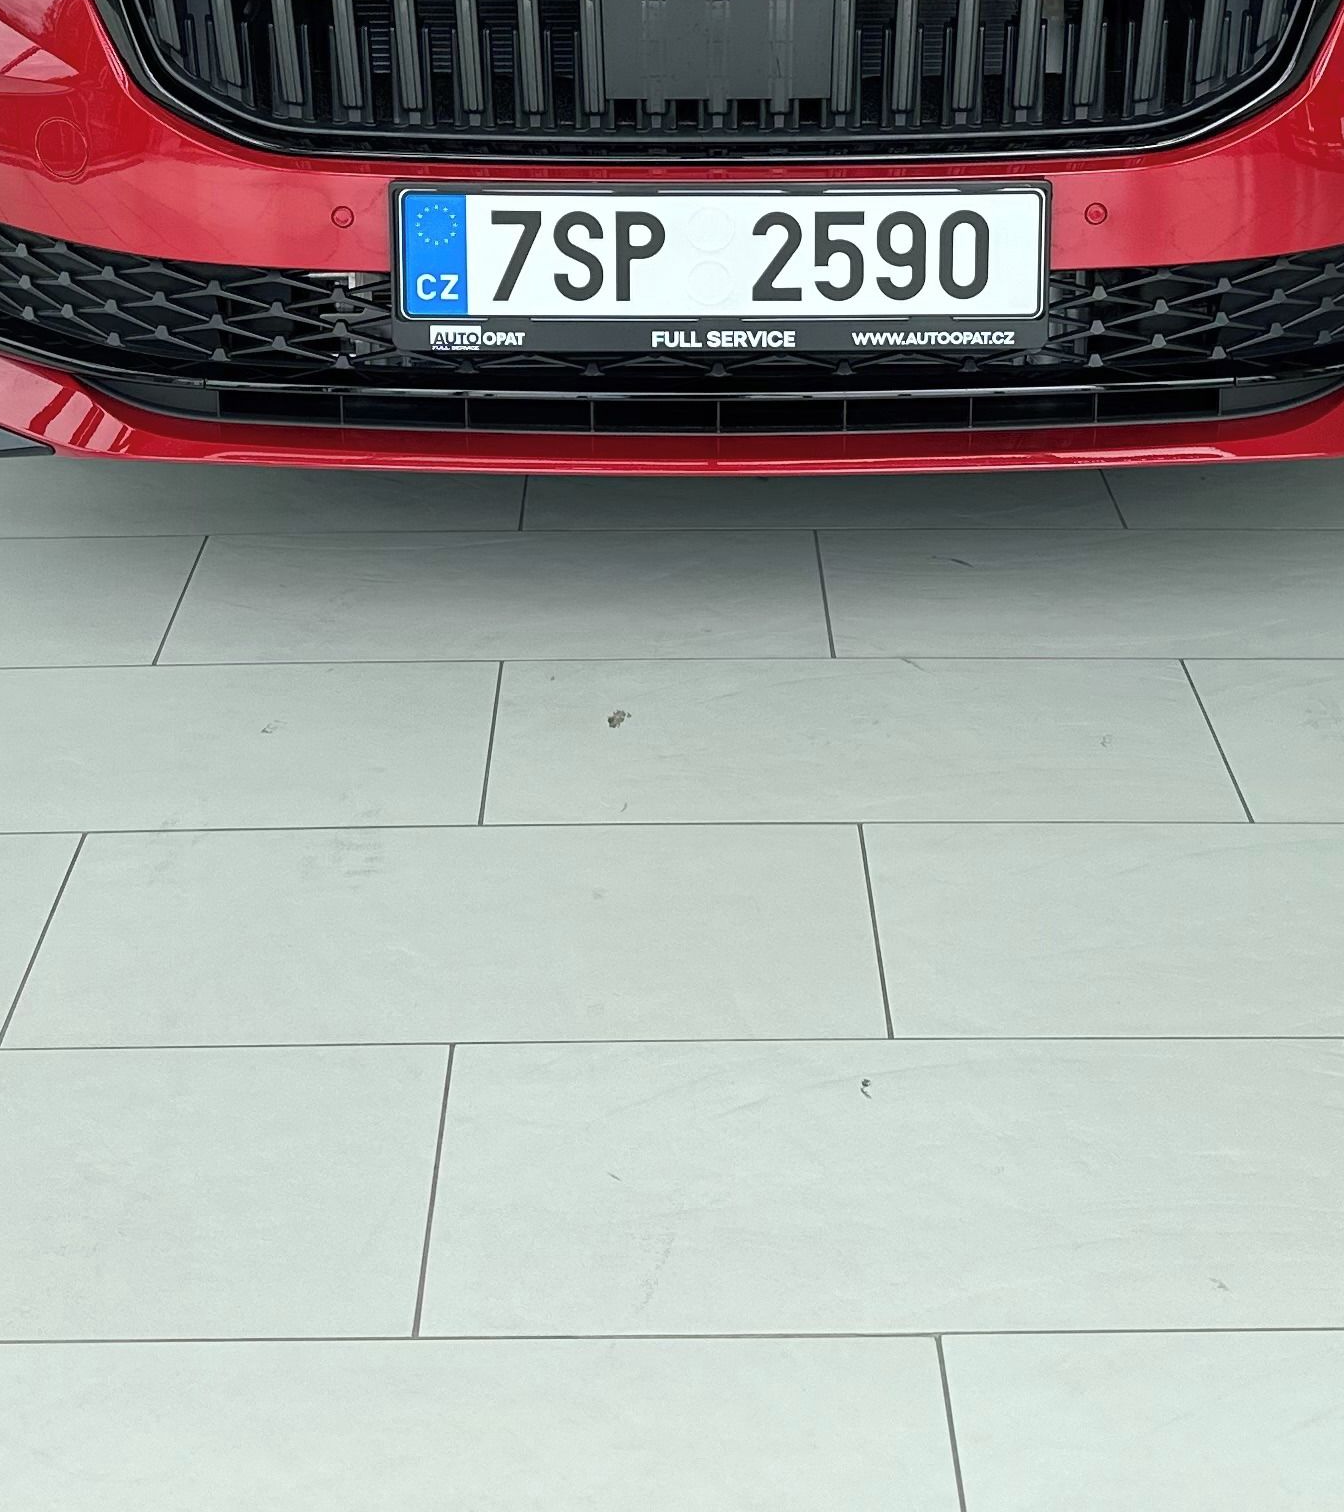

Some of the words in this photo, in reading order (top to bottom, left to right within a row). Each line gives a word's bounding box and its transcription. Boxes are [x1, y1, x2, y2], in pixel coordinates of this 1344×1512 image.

[491, 210, 665, 302] 7SP
[752, 209, 989, 302] 2590
[416, 273, 459, 300] CZ
[651, 330, 702, 348] FULL
[706, 330, 796, 348] SERVICE
[851, 331, 1015, 346] WWW.AUTOOPAT.CZ
